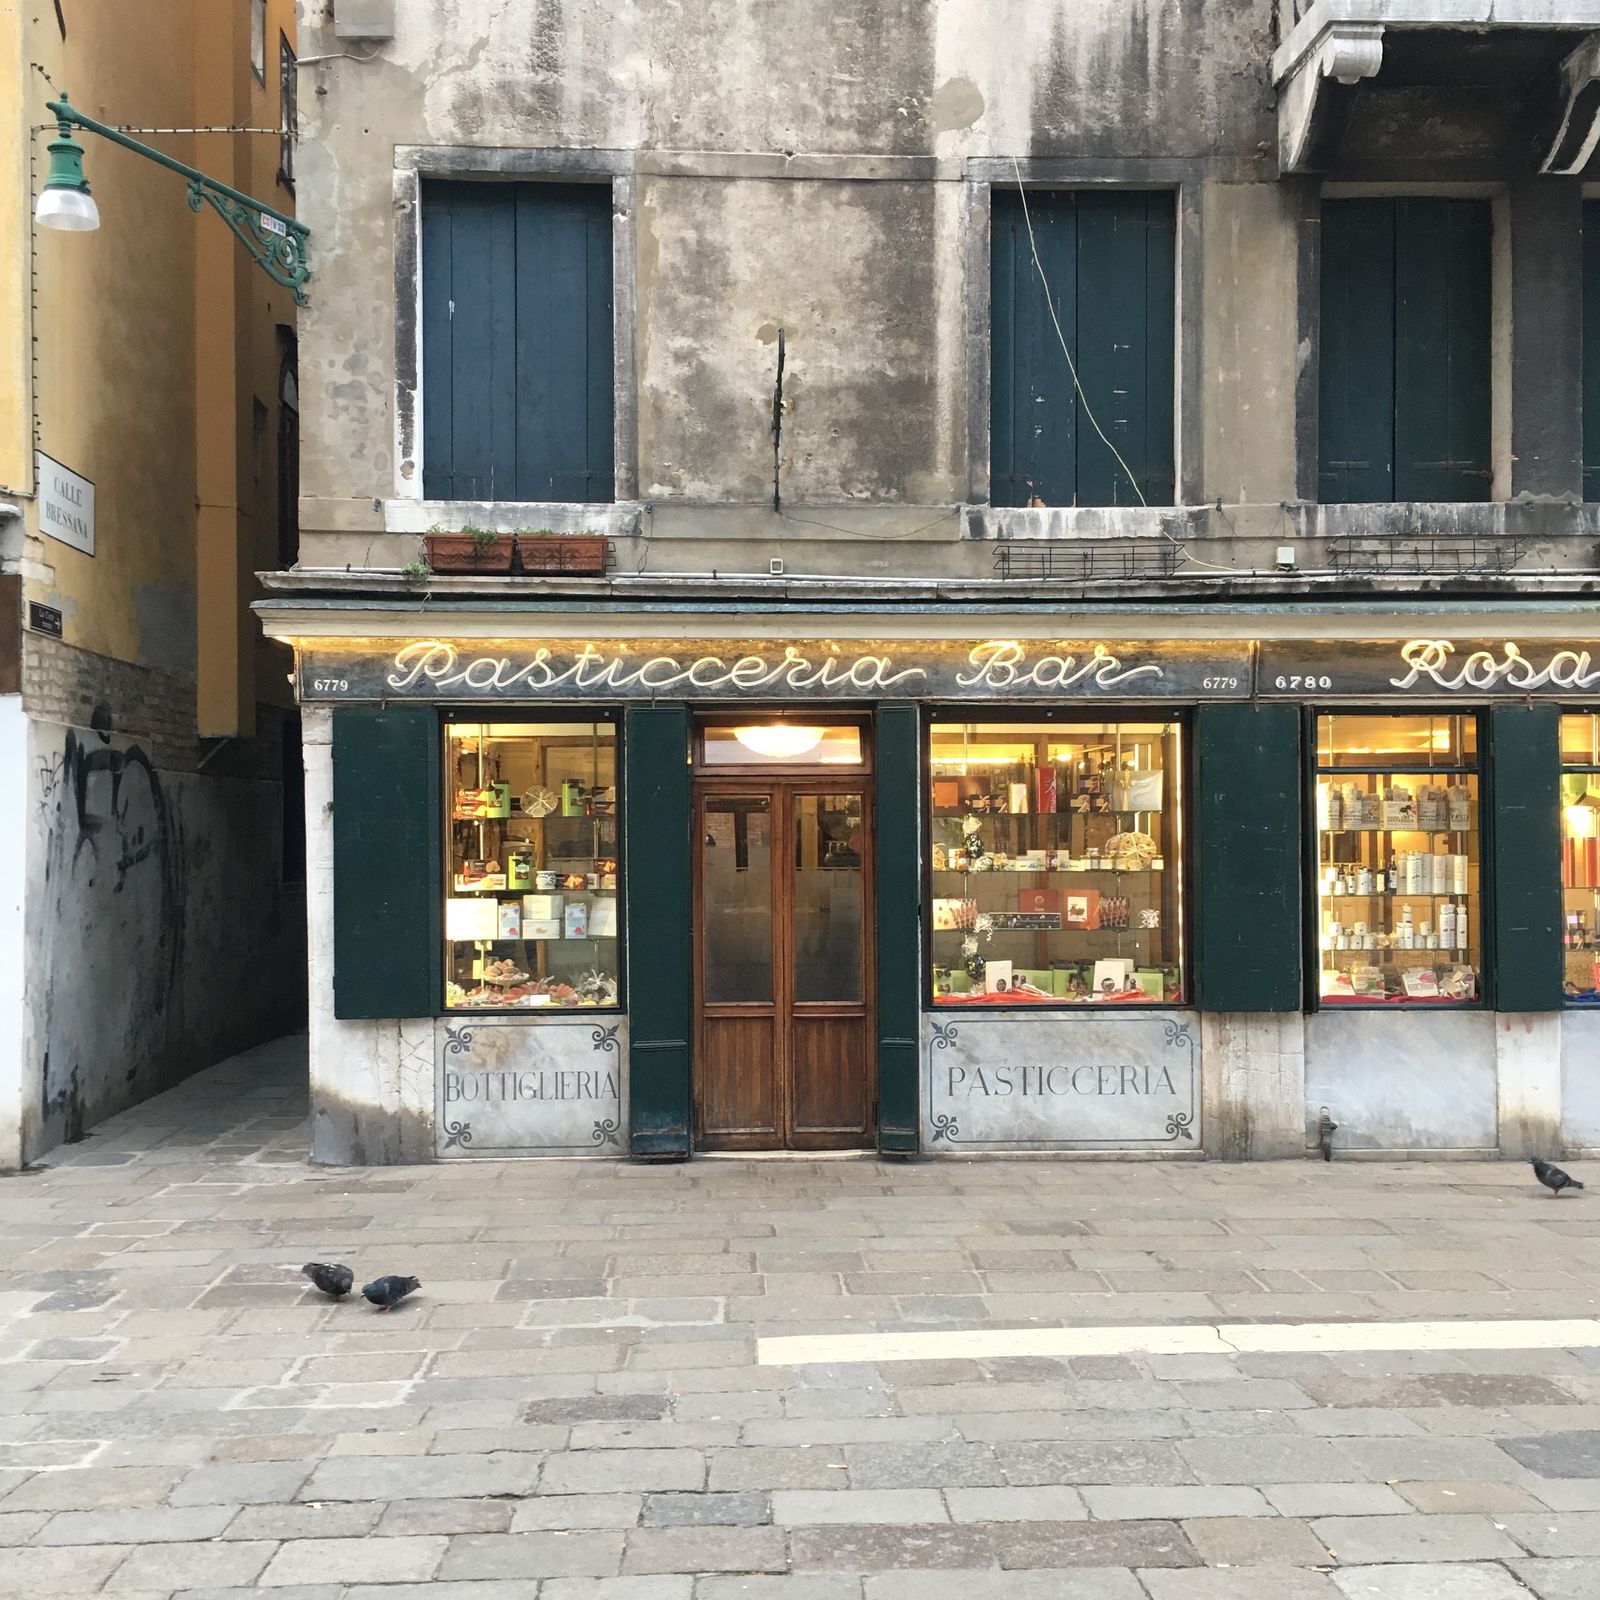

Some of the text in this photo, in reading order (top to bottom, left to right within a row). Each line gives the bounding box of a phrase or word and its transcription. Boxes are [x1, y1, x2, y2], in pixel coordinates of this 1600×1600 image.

[54, 476, 82, 507] CALLE
[46, 501, 88, 539] BRESSANA
[387, 640, 1164, 690] Pasticceria Bar
[1389, 639, 1600, 690] Rosa
[313, 679, 349, 692] 6779
[1202, 677, 1237, 690] 6779
[1274, 676, 1332, 690] 6780
[446, 1071, 618, 1102] BOTTIGLIERIA
[948, 1065, 1177, 1097] PASTICCERIA
